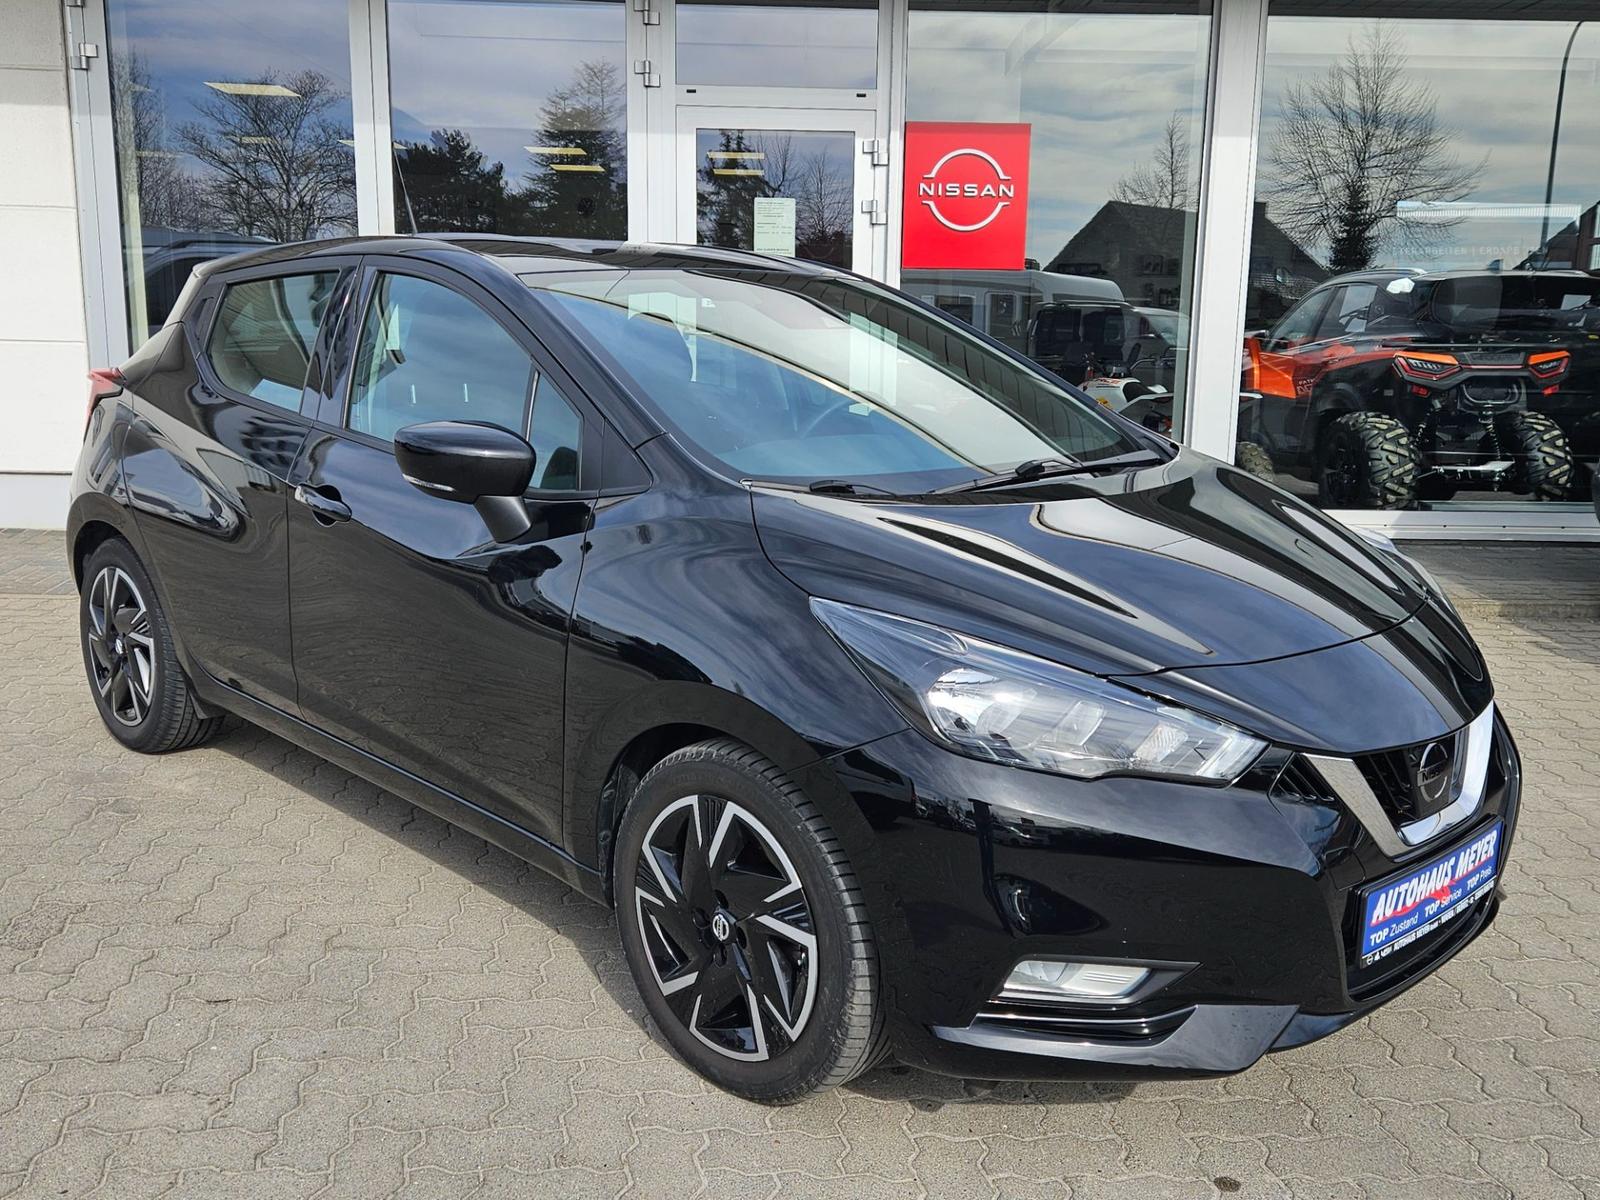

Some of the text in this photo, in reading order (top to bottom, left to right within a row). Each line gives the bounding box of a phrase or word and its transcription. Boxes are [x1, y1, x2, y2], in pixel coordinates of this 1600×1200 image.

[919, 182, 1014, 197] NISSAN
[1370, 929, 1390, 946] TOP
[1390, 912, 1418, 936] Zustand
[1425, 901, 1440, 917] TOP
[1441, 888, 1462, 908] Service
[1467, 876, 1479, 890] TOP
[1372, 831, 1497, 923] AUTOHAUS MEYER
